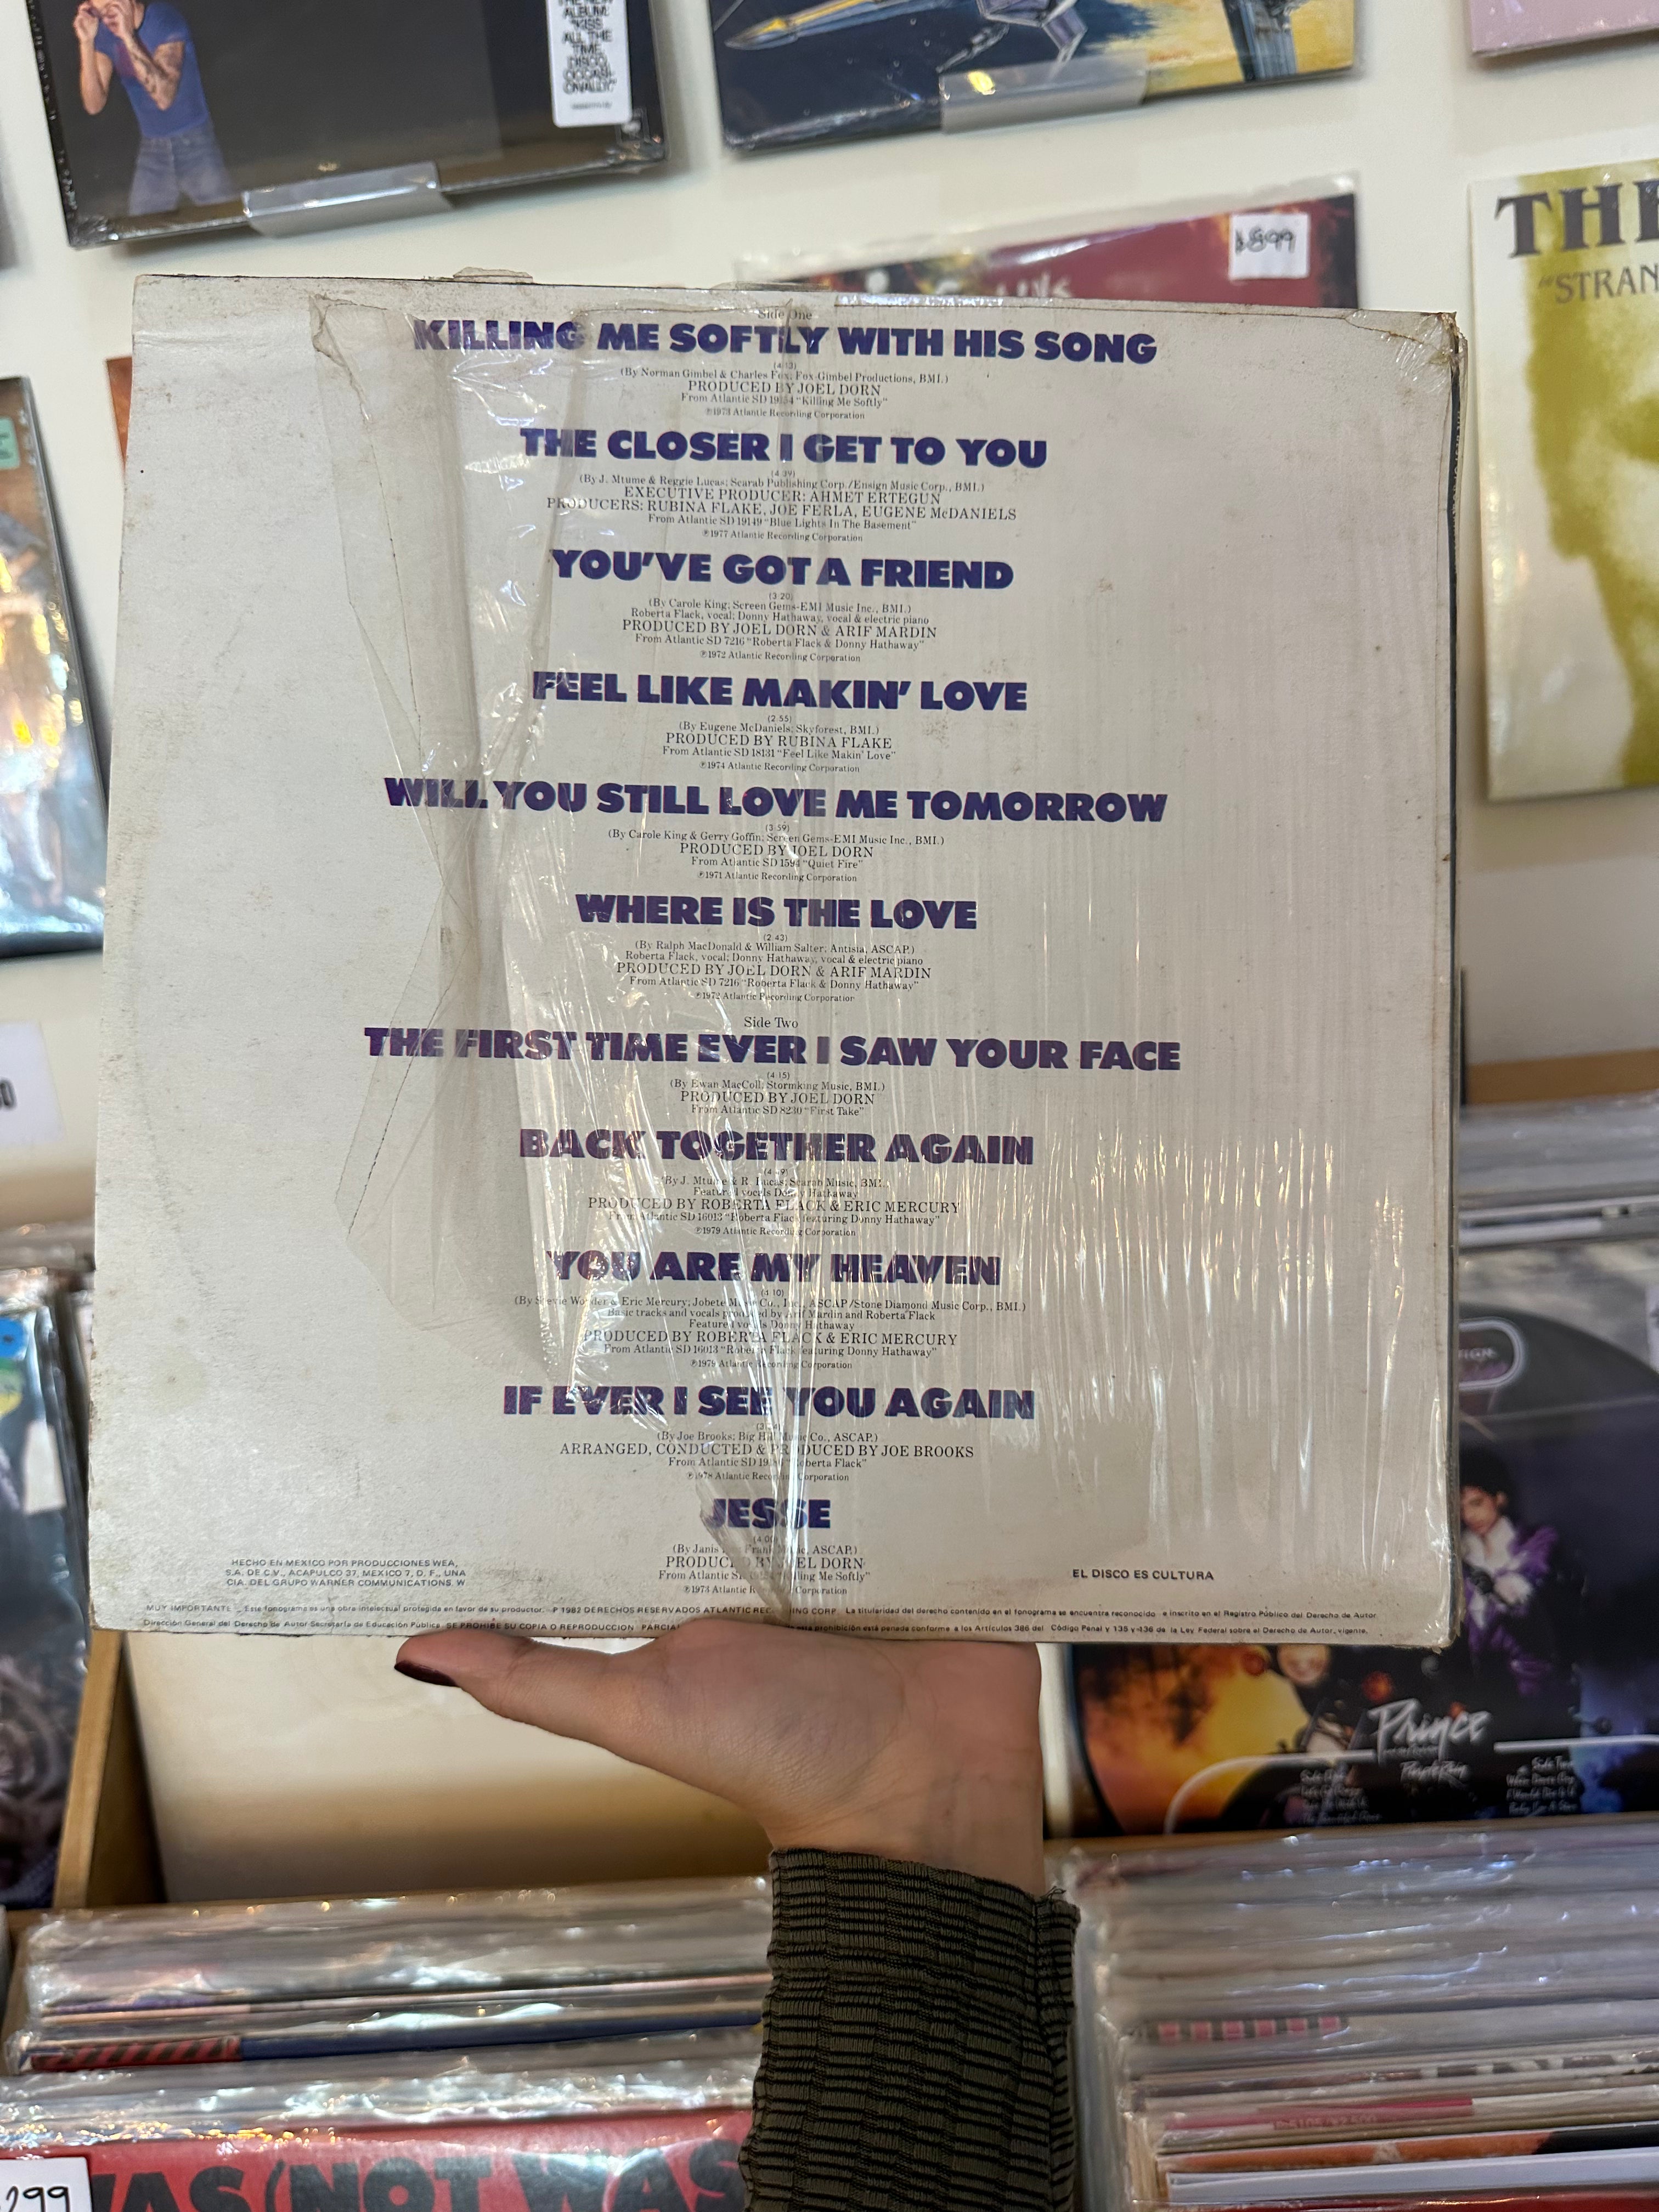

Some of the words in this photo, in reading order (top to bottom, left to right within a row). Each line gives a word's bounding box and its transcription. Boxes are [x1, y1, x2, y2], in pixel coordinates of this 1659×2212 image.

[414, 319, 585, 350] KILLING
[597, 323, 659, 351] ME
[669, 321, 830, 355] SOFTLY
[837, 327, 944, 356] WITH
[953, 329, 1025, 359] HIS
[1035, 331, 1157, 364] SONG
[688, 380, 771, 394] PRODUCED
[797, 383, 836, 396] JOEL
[839, 383, 881, 397] DORN
[520, 428, 597, 458] THE
[607, 430, 770, 462] CLOSER
[780, 433, 793, 461] I
[803, 433, 882, 465] GET
[890, 436, 946, 466] TO
[956, 438, 1047, 469] YOU
[624, 486, 714, 500] EXECUTIVE
[718, 488, 806, 502] PRODUCER:
[809, 490, 864, 503] AHMET
[867, 491, 940, 505] ERTEGUN
[647, 499, 707, 513] RUBINA
[711, 501, 766, 516] FLAKE,
[769, 502, 798, 515] JOE
[802, 503, 857, 518] FERLA,
[862, 504, 927, 518] EUGENE
[930, 506, 1017, 520] McDANIELS
[648, 514, 675, 524] From
[677, 514, 718, 526] Atlantic
[719, 515, 735, 526] SD
[737, 516, 762, 527] 19149
[795, 517, 826, 531] Lights
[830, 518, 840, 529] In
[842, 518, 860, 529] The
[723, 554, 812, 585] GOT
[816, 557, 851, 586] A
[861, 558, 1014, 590] FRIEND
[622, 619, 707, 633] PRODUCED
[710, 621, 730, 634] BY
[732, 622, 771, 635] JOEL
[775, 623, 817, 635] DORN
[821, 624, 831, 636] &
[836, 624, 872, 637] ARIF
[876, 625, 937, 638] MARDIN
[532, 672, 627, 702] FEEL
[637, 675, 732, 706] LIKE
[921, 680, 1027, 712] LOVE
[665, 732, 750, 746] PRODUCED
[753, 734, 774, 747] BY
[777, 735, 837, 748] RUBINA
[841, 736, 892, 749] FLAKE
[384, 777, 488, 809] WILL
[493, 780, 587, 812] YOU
[596, 782, 709, 815] STILL
[719, 786, 826, 817] LOVE
[835, 790, 898, 819] ME
[906, 789, 1168, 824] TOMORROW
[691, 856, 718, 867] From
[720, 857, 760, 868] Atlantic
[762, 857, 778, 868] SD
[779, 858, 802, 868] 1594
[575, 894, 723, 925] WHERE
[732, 896, 775, 927] IS
[783, 899, 860, 927] THE
[870, 899, 977, 930] LOVE
[744, 1017, 770, 1029] Side
[774, 1017, 799, 1029] Two
[364, 1028, 444, 1057] THE
[455, 1029, 577, 1060] FIRST
[585, 1032, 688, 1062] TIME
[697, 1034, 808, 1064] EVER
[816, 1036, 830, 1064] I
[840, 1036, 938, 1067] SAW
[945, 1037, 1069, 1070] YOUR
[1080, 1040, 1181, 1071] FACE
[680, 1091, 764, 1104] PRODUCED
[768, 1092, 788, 1104] BY
[791, 1092, 828, 1105] JOEL
[833, 1093, 874, 1105] DORN
[520, 1128, 645, 1160] BACK
[656, 1130, 877, 1163] TOGETHER
[884, 1133, 1034, 1165] AGAIN
[547, 1250, 641, 1281] YOU
[649, 1251, 741, 1281] ARE
[750, 1252, 820, 1283] MY
[830, 1252, 1001, 1285] HEAVEN
[504, 1386, 543, 1414] IF
[552, 1386, 665, 1415] EVER
[674, 1386, 688, 1415] I
[698, 1386, 772, 1417] SEE
[783, 1386, 876, 1418] YOU
[884, 1387, 1035, 1419] AGAIN
[560, 1443, 652, 1457] ARRANGED,
[656, 1443, 753, 1456] CONDUCTED
[756, 1444, 766, 1456] &
[858, 1444, 878, 1457] BY
[881, 1444, 909, 1457] JOE
[913, 1444, 974, 1457] BROOKS
[707, 1497, 831, 1532] JESSE
[232, 1558, 267, 1567] HECHO
[270, 1558, 283, 1567] EN
[286, 1558, 325, 1567] MEXICO
[328, 1558, 349, 1567] POR
[351, 1559, 430, 1567] PRODUCCIONES
[433, 1559, 459, 1568] WEA,
[227, 1578, 247, 1587] CIA.
[250, 1578, 270, 1587] DEL
[273, 1578, 308, 1587] GRUPO
[311, 1578, 354, 1587] WARNER
[457, 1578, 465, 1587] W
[1072, 1568, 1088, 1578] EL
[1091, 1569, 1131, 1579] DISCO
[1133, 1570, 1149, 1579] ES
[1152, 1570, 1215, 1581] CULTURA
[1368, 1699, 1492, 1767] Prince
